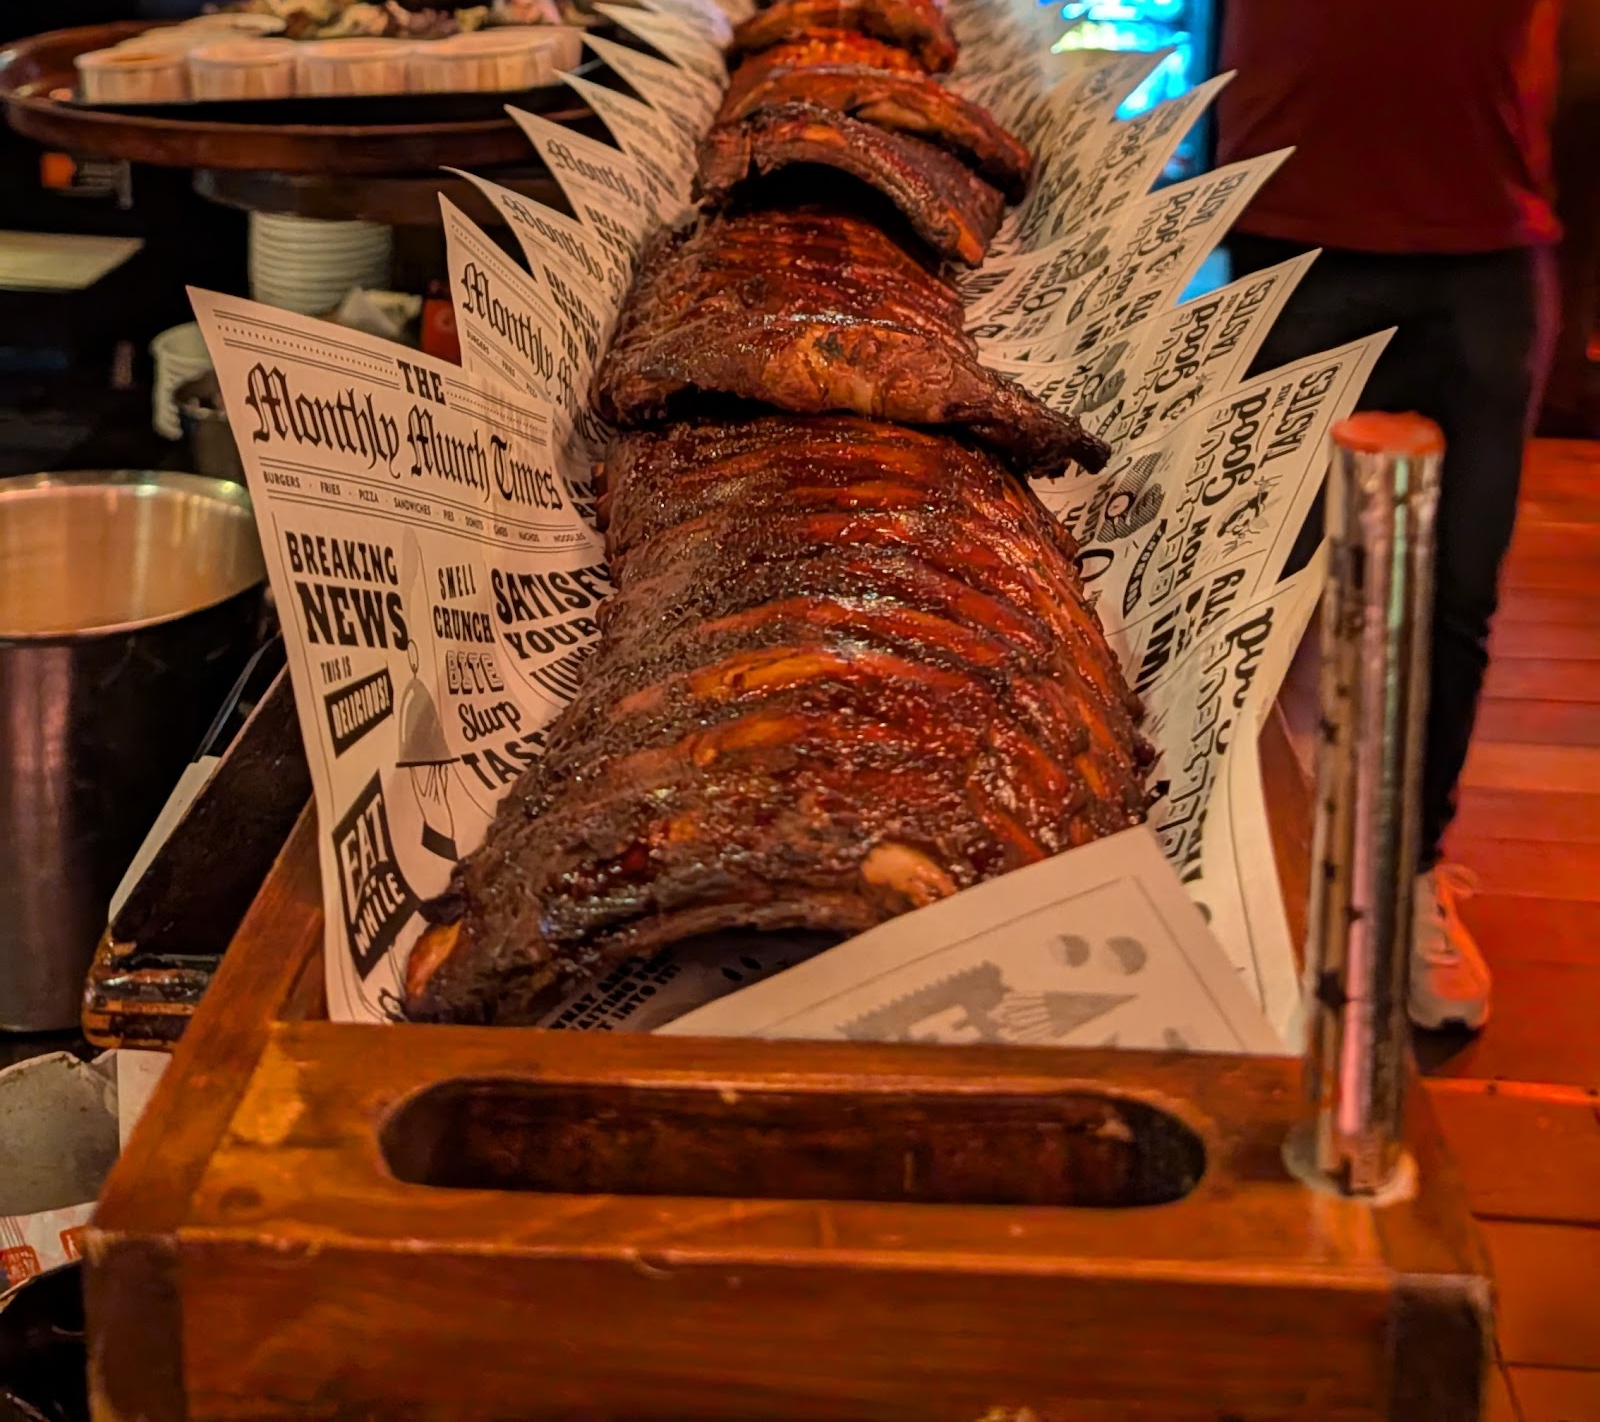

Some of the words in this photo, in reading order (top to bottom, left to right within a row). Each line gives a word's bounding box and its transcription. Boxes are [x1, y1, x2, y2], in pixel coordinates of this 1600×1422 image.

[501, 193, 604, 283] Monthly
[461, 262, 554, 396] Monthly
[1154, 296, 1225, 394] Good
[1201, 275, 1279, 366] TASTES
[396, 359, 447, 406] THE
[1258, 361, 1343, 470] TASTES
[245, 361, 400, 478] Monthly
[407, 404, 491, 502] Munch
[490, 434, 564, 511] Times
[263, 471, 301, 489] BURGERS
[320, 481, 341, 496] FRIES
[358, 489, 379, 504] PIZZA
[393, 497, 431, 516] SANDWICHES
[1149, 406, 1238, 606] BELIEVE
[1174, 515, 1213, 590] HOW
[1201, 386, 1271, 506] Good
[1272, 382, 1294, 410] THIS
[284, 530, 399, 585] BREAKING
[438, 563, 477, 600] SMELL
[294, 581, 409, 651] NEWS
[433, 605, 496, 644] CRUNCH
[321, 658, 342, 685] THIS
[342, 655, 352, 678] IS
[446, 649, 504, 695] BITE
[458, 700, 521, 742] Slurp
[340, 793, 388, 924] EAT
[354, 872, 406, 957] WHILE
